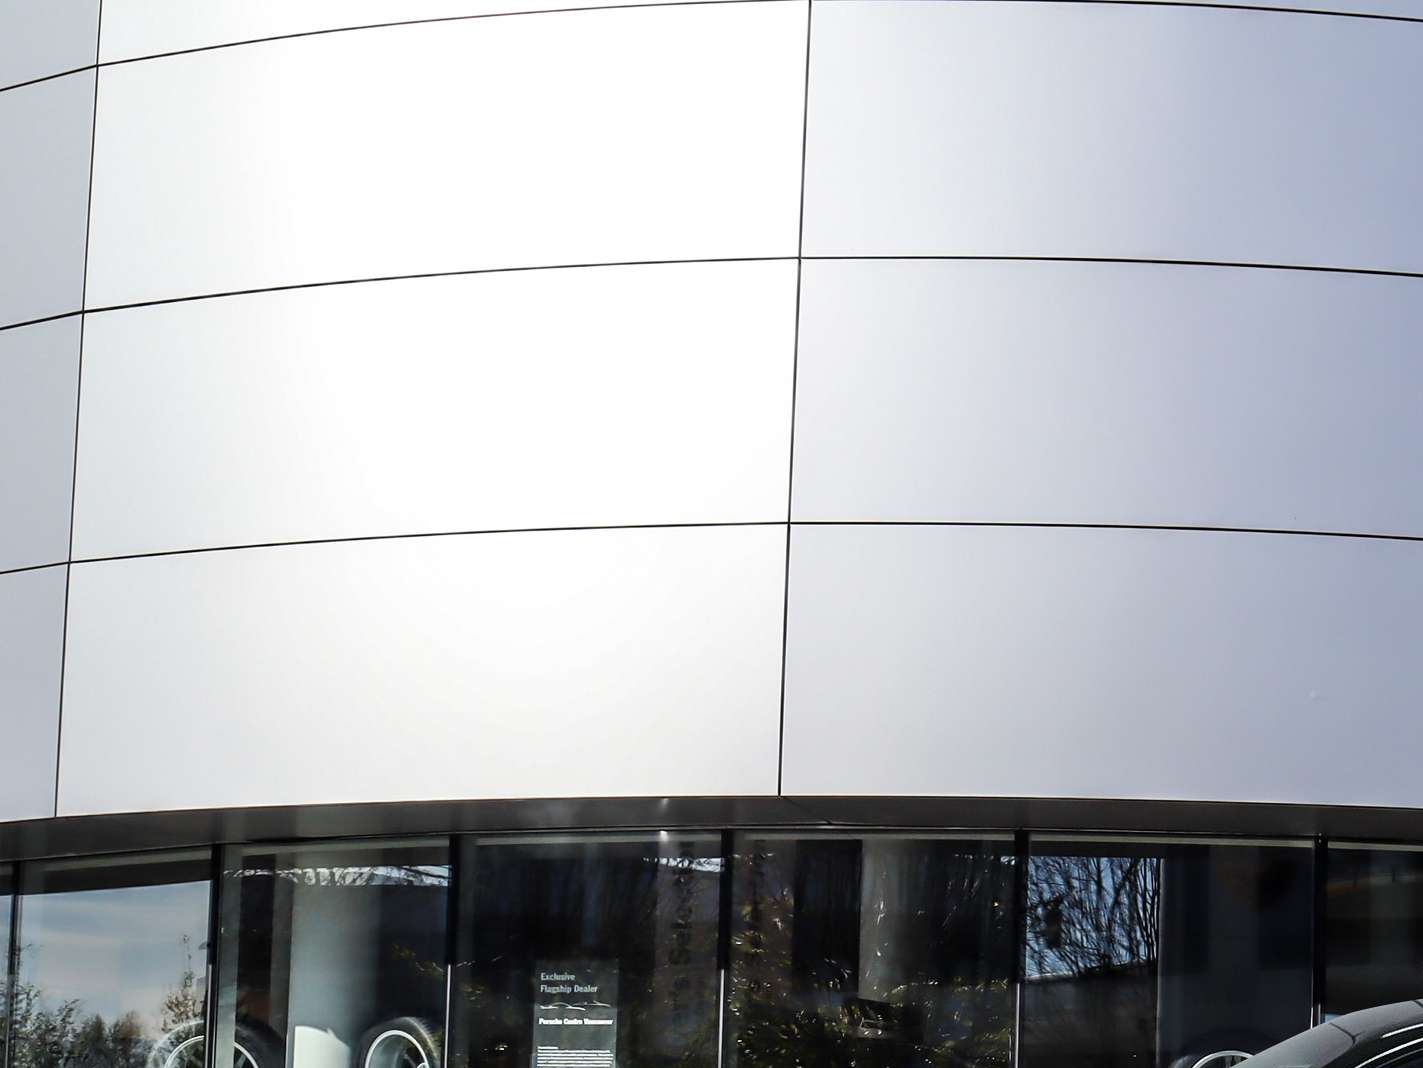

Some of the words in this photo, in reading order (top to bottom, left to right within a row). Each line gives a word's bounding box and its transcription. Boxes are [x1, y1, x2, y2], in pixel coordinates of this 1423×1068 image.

[541, 972, 576, 982] Exclusive
[540, 984, 572, 994] Flagship
[574, 984, 599, 993] Dealer
